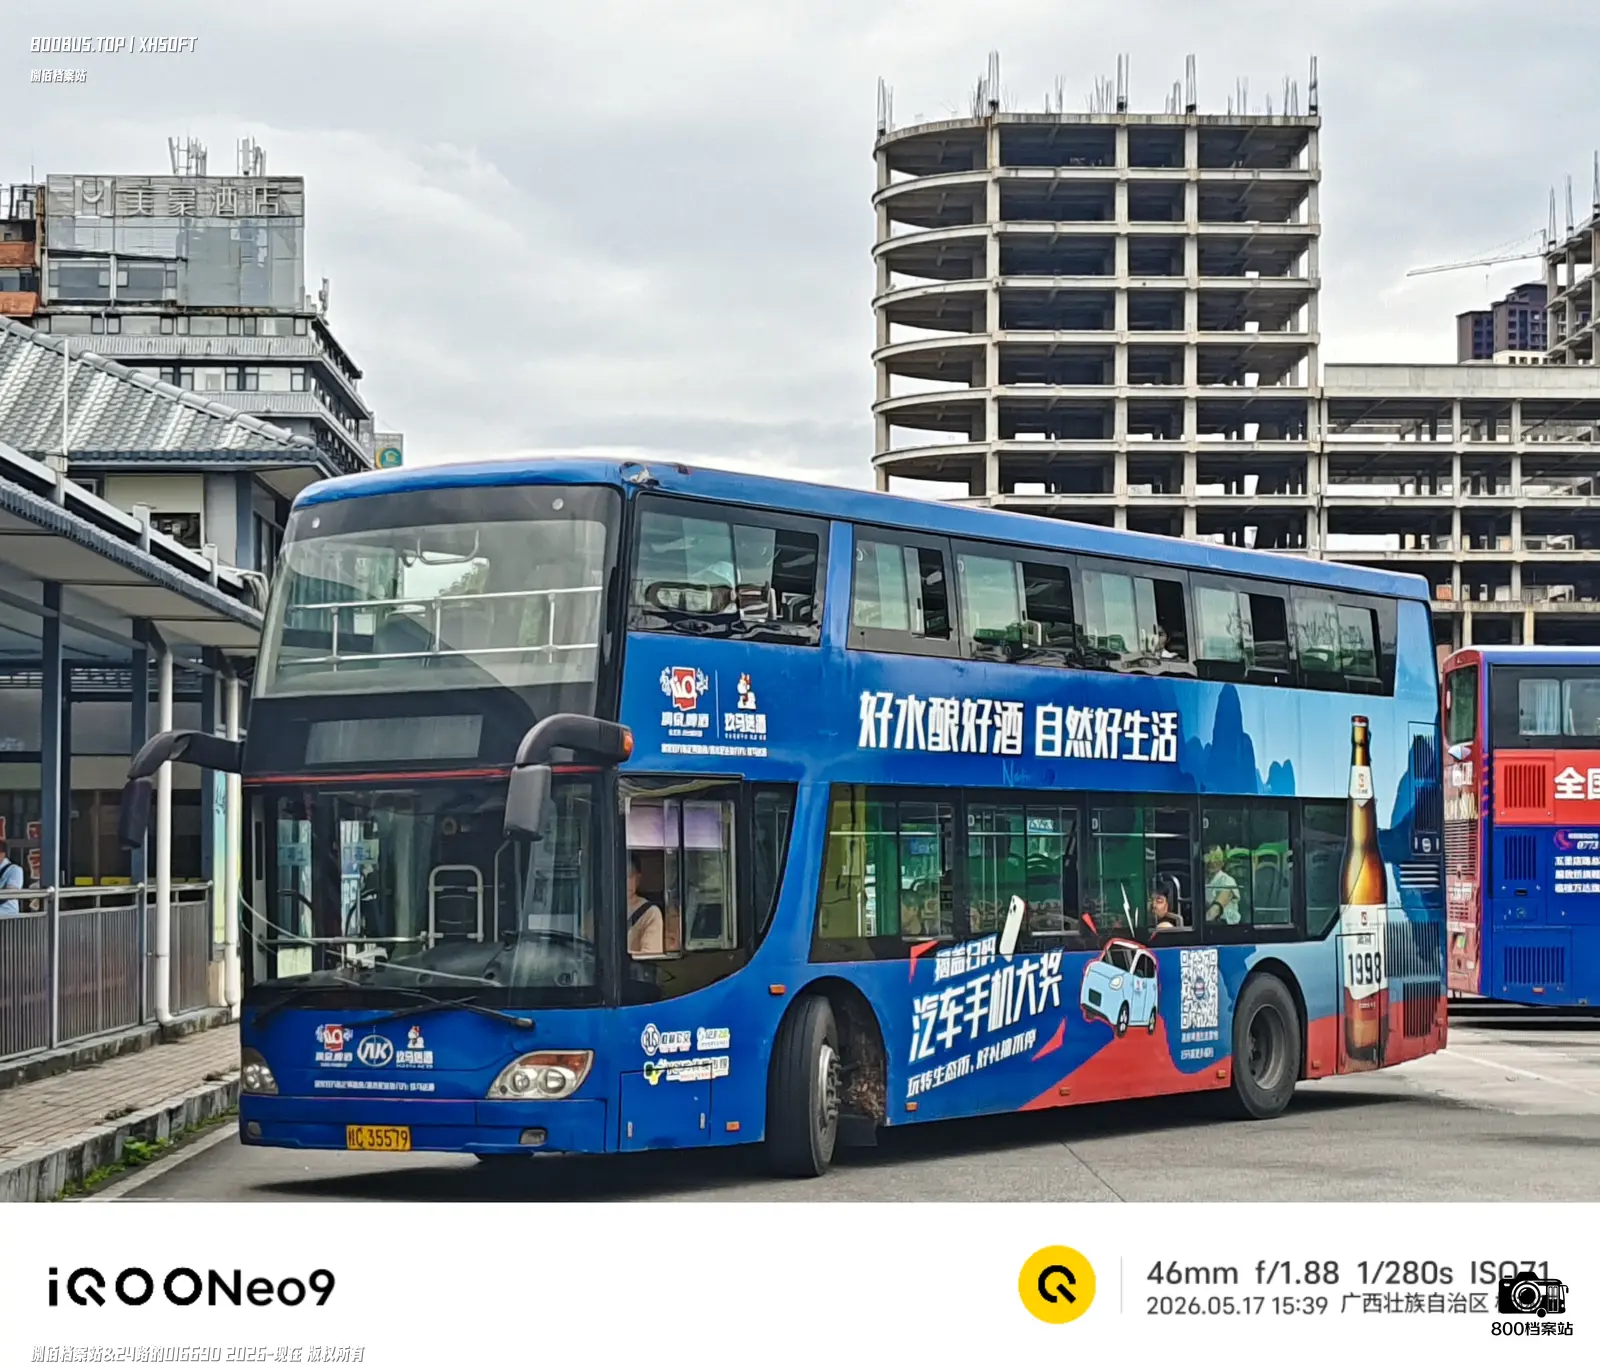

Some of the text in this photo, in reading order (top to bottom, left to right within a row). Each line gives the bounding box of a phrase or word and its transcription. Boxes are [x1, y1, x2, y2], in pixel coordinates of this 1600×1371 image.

[858, 690, 1178, 762] 好水酿好酒 自然好生活
[1348, 951, 1382, 986] 1998
[909, 949, 1063, 1063] 汽车手机大奖
[367, 1129, 409, 1148] 35579
